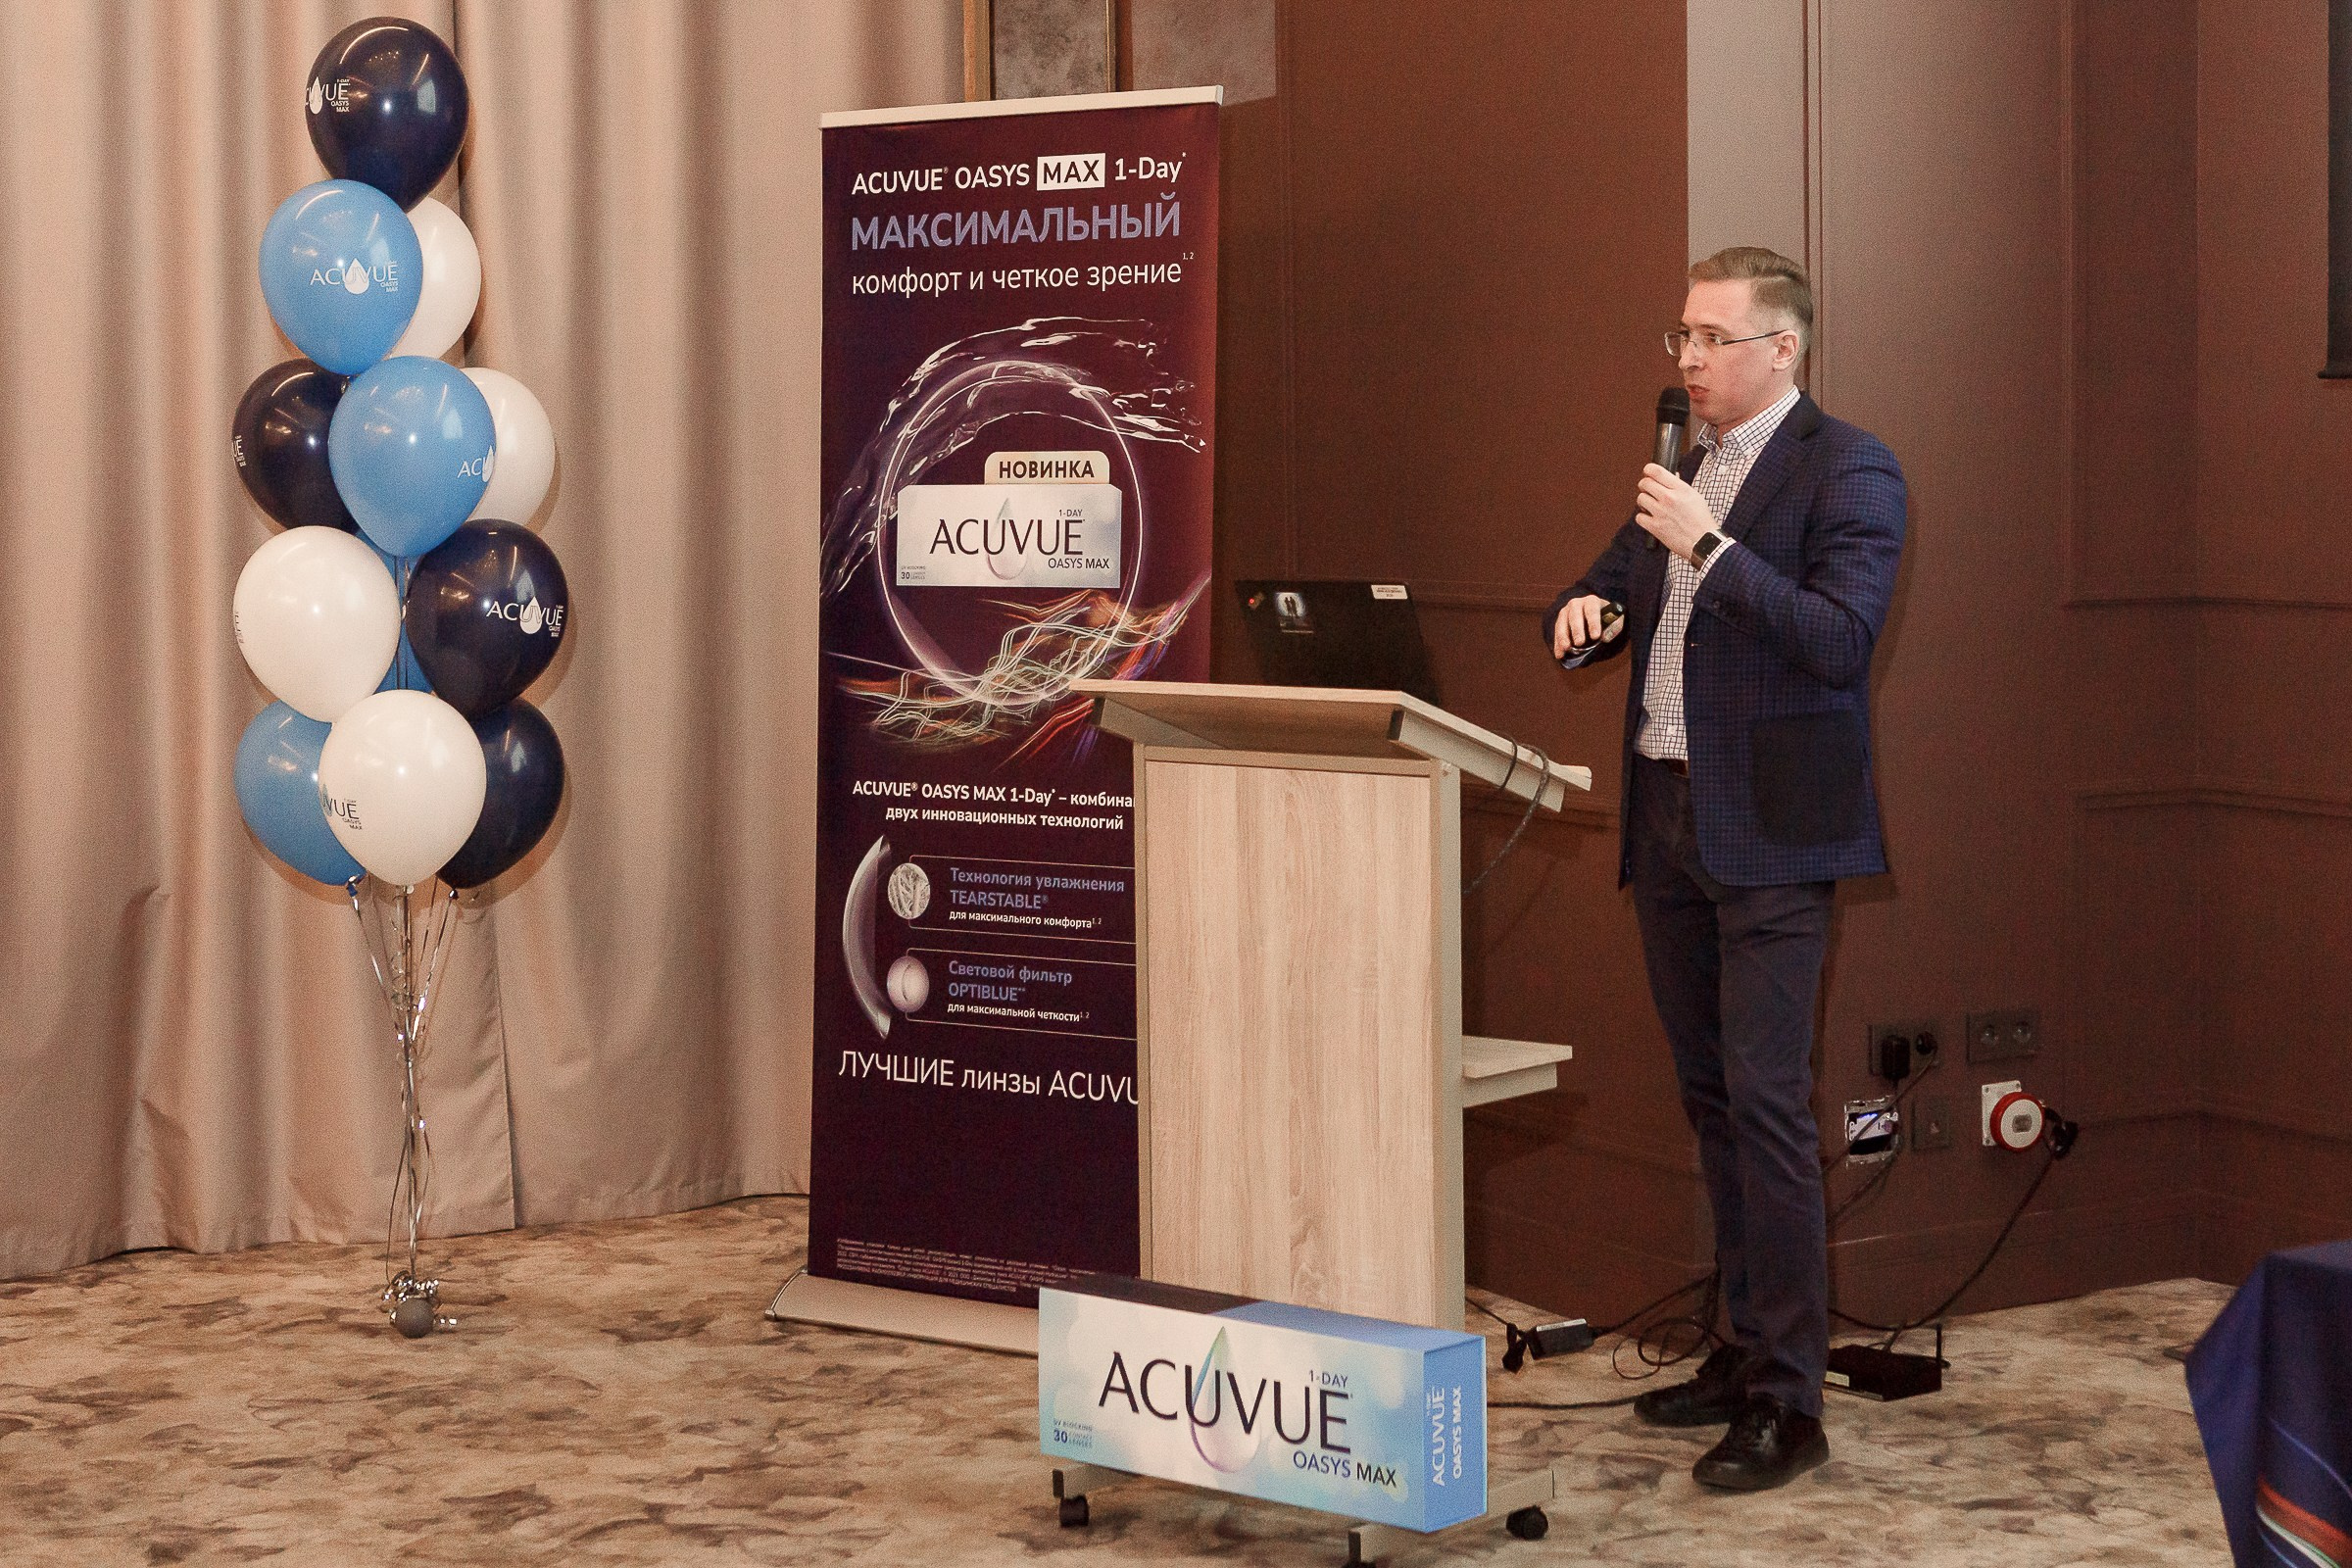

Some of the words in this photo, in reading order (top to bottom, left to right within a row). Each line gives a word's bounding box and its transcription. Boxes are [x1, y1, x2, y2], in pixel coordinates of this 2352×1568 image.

[955, 163, 1030, 191] OASYS
[1043, 159, 1100, 185] MAX
[852, 191, 1180, 251] МАКСИМАЛЬНЫЙ
[309, 263, 399, 286] ACUVUE
[853, 266, 962, 298] комфорт
[969, 270, 984, 291] и
[992, 264, 1079, 289] четкое
[999, 460, 1095, 478] НОВИНКА
[1058, 509, 1083, 517] 1-DAY
[929, 518, 1085, 556] ACUVUE
[1048, 558, 1083, 569] OASYS
[1085, 558, 1109, 569] MAX
[485, 600, 564, 626] ACUVUE
[921, 783, 969, 800] OASYS
[973, 786, 1006, 802] MAX
[1070, 794, 1135, 808] комбина
[886, 807, 918, 821] двух
[921, 808, 1037, 827] инновационных
[1041, 814, 1124, 830] технологий
[950, 867, 1032, 887] Технология
[1036, 874, 1125, 892] увлажнения
[949, 910, 966, 921] для
[968, 911, 1042, 925] максимального
[949, 959, 1015, 979] Световой
[1018, 965, 1072, 986] фильтр
[947, 1003, 965, 1013] для
[966, 1004, 1036, 1019] максимальной
[839, 1050, 955, 1087] ЛУЧШИЕ
[961, 1068, 1041, 1096] линзы
[1308, 1369, 1348, 1389] 1-DAY
[1098, 1351, 1351, 1454] ACUVUE
[1452, 1385, 1462, 1424] MAX
[1432, 1386, 1446, 1486] ACUVUE
[1452, 1425, 1462, 1480] OASYS
[1293, 1450, 1351, 1478] OASYS
[1356, 1465, 1397, 1488] MAX
